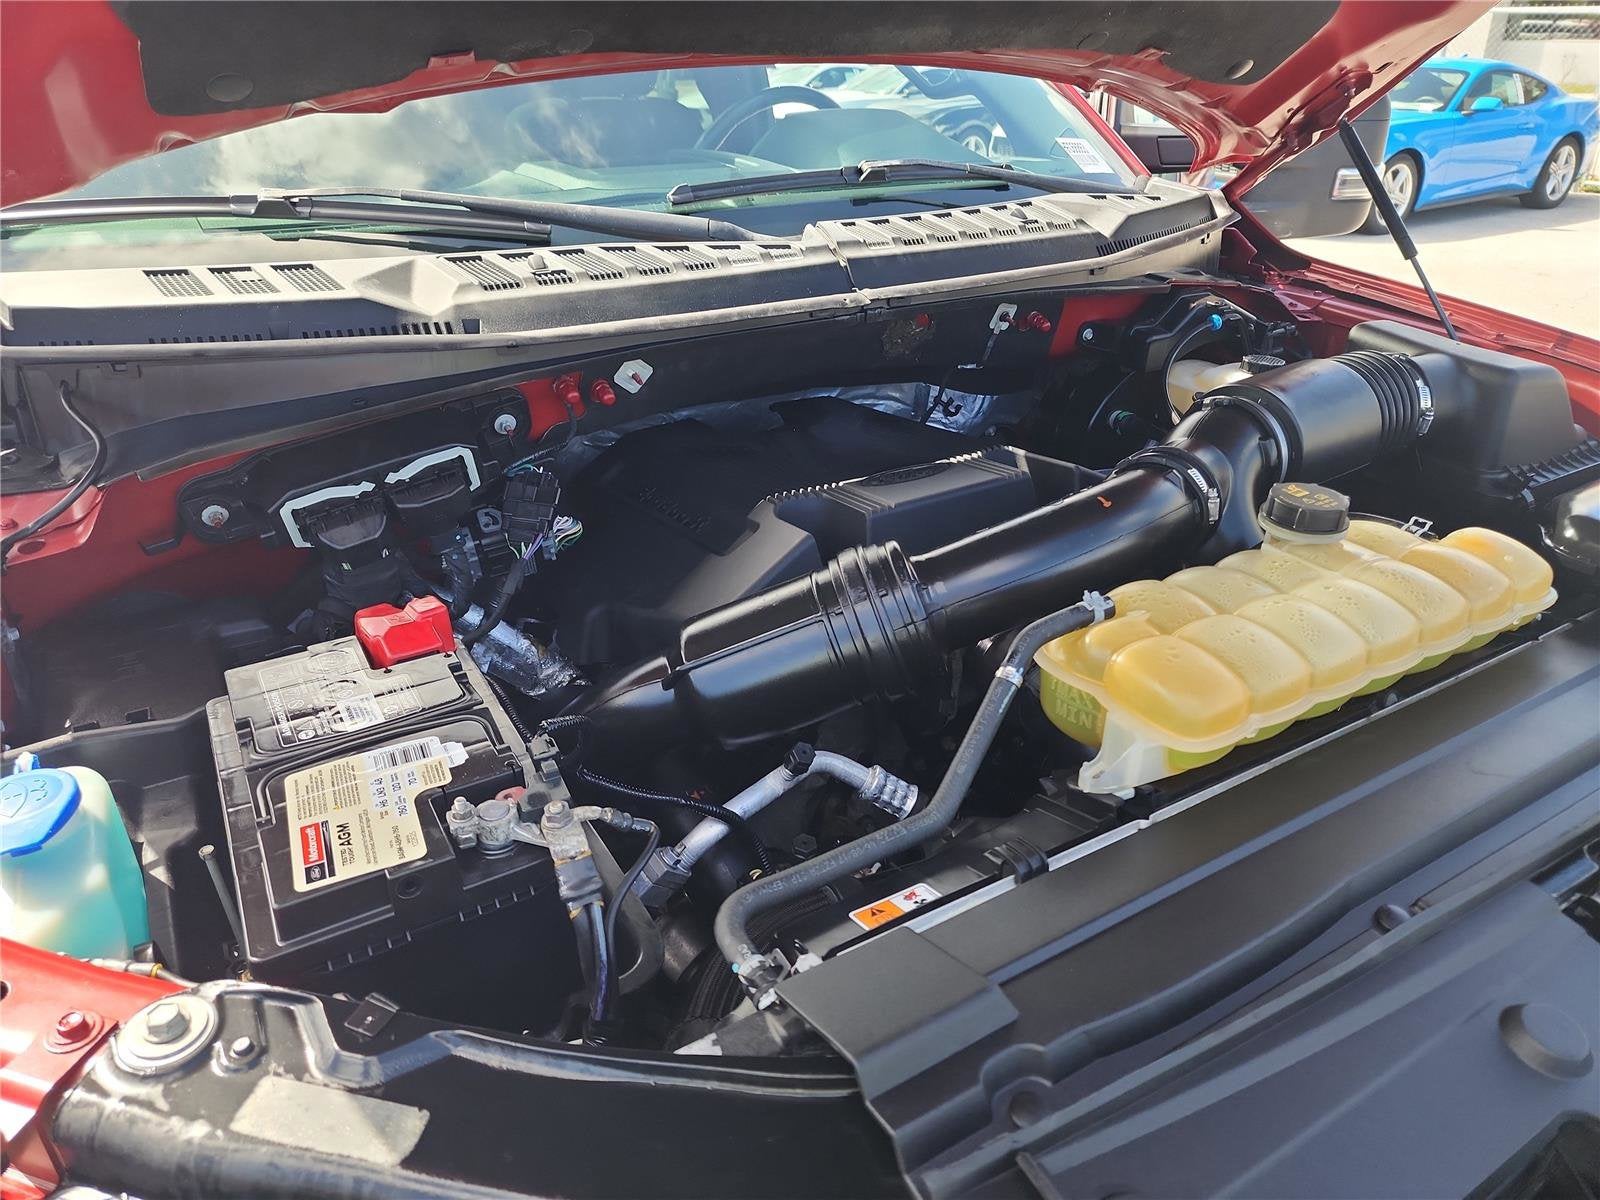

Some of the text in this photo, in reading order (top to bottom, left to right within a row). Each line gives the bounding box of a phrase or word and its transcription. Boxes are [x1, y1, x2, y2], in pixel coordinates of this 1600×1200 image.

[1056, 700, 1092, 729] MIN
[304, 826, 319, 862] Motorcraft
[336, 822, 353, 846] AGM
